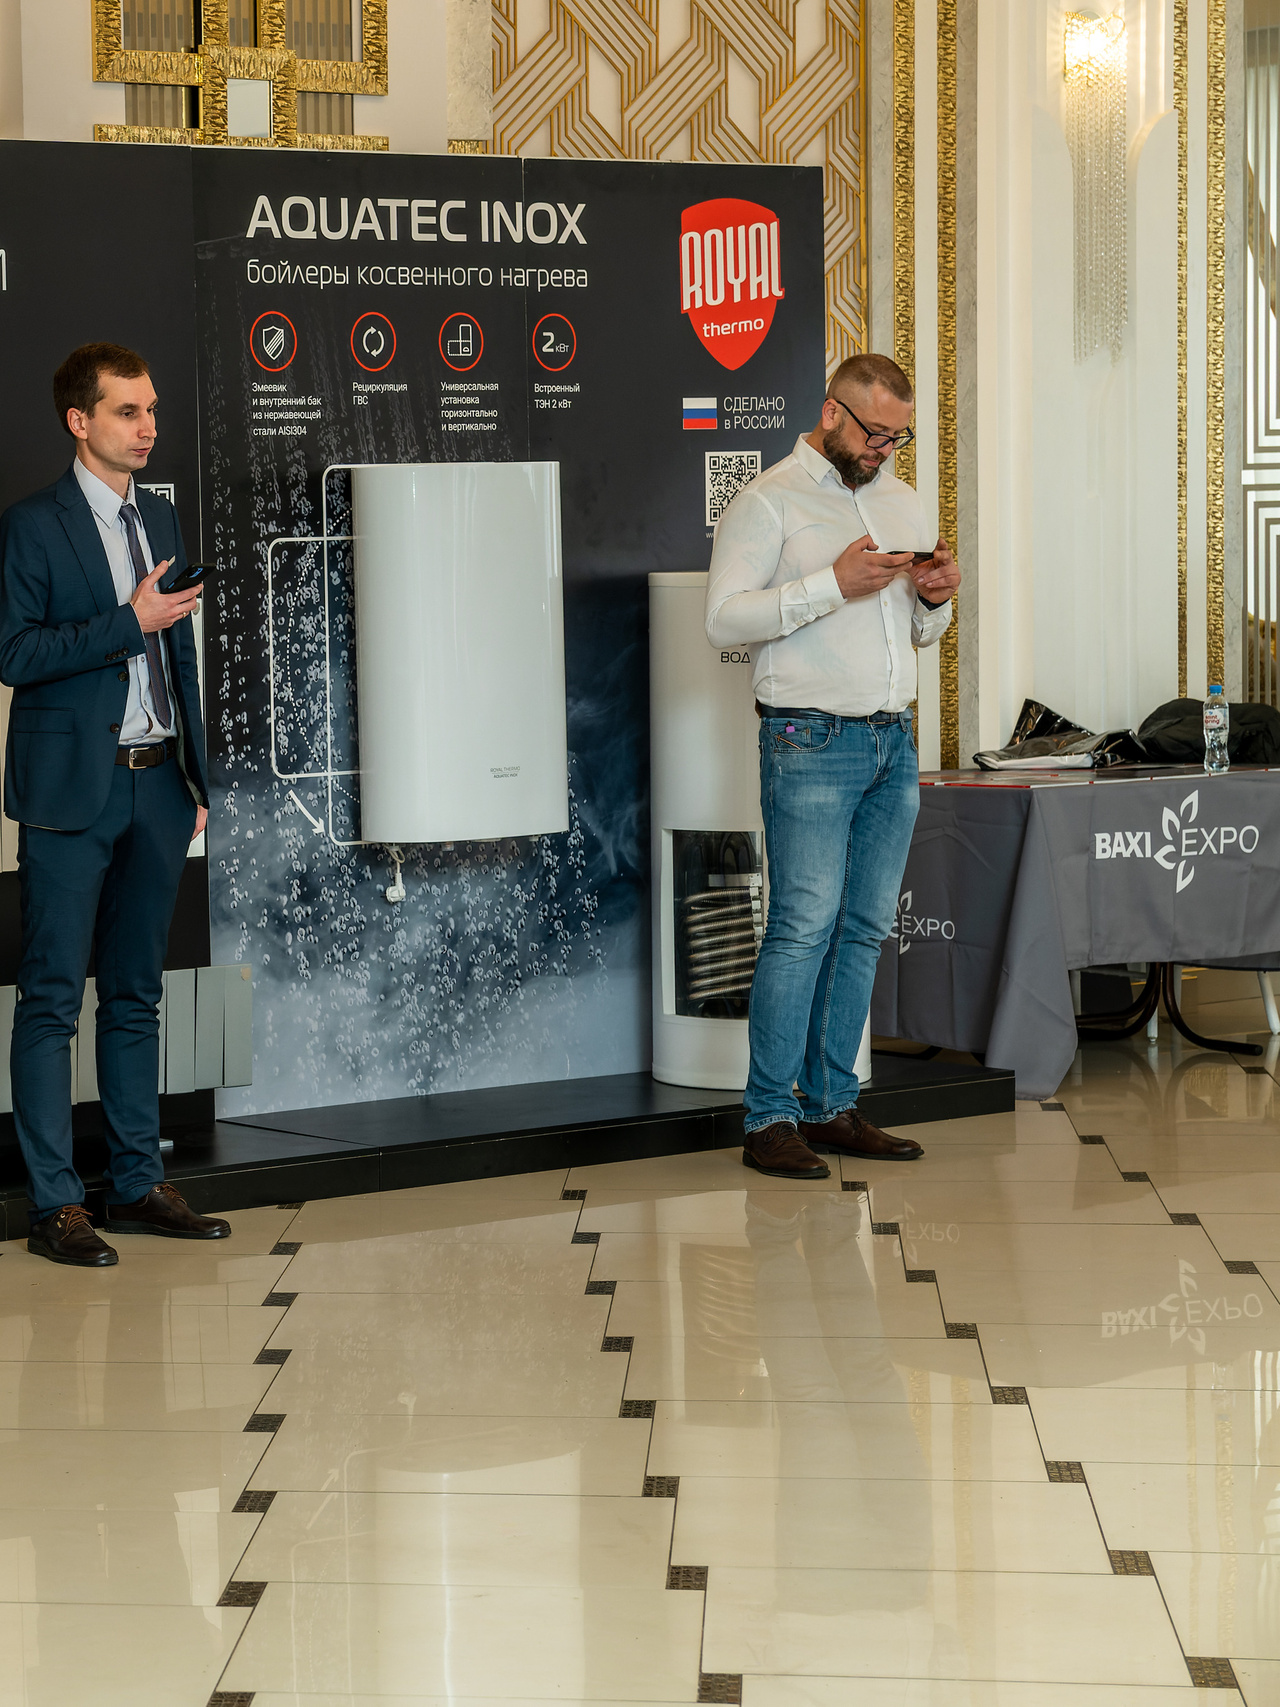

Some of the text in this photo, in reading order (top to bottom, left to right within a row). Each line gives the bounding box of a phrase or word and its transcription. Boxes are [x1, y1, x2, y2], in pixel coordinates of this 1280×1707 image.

[246, 195, 587, 244] AQUATEC INOX
[681, 221, 783, 311] ROYAL
[246, 259, 588, 292] бойлеры косвенного нагрева
[702, 318, 764, 338] thermo
[542, 331, 570, 353] 2 кВт
[252, 382, 287, 392] Змеевик
[352, 382, 408, 393] Рециркуляция
[440, 382, 499, 393] Универсальная
[534, 383, 581, 394] Встроенный
[252, 396, 322, 407] и внутренний бак
[352, 396, 369, 406] ГВС
[440, 396, 480, 407] установка
[535, 400, 572, 409] ТЭН 2 кВт
[723, 396, 785, 413] СДЕЛАНО
[252, 410, 321, 421] из нержавеющей
[441, 409, 498, 420] горизонтально
[441, 423, 497, 433] и вертикально
[724, 415, 785, 430] в РОССИИ
[253, 425, 307, 436] стали AISI304
[1094, 825, 1260, 860] BAXI EXPO
[901, 914, 956, 940] EXPO
